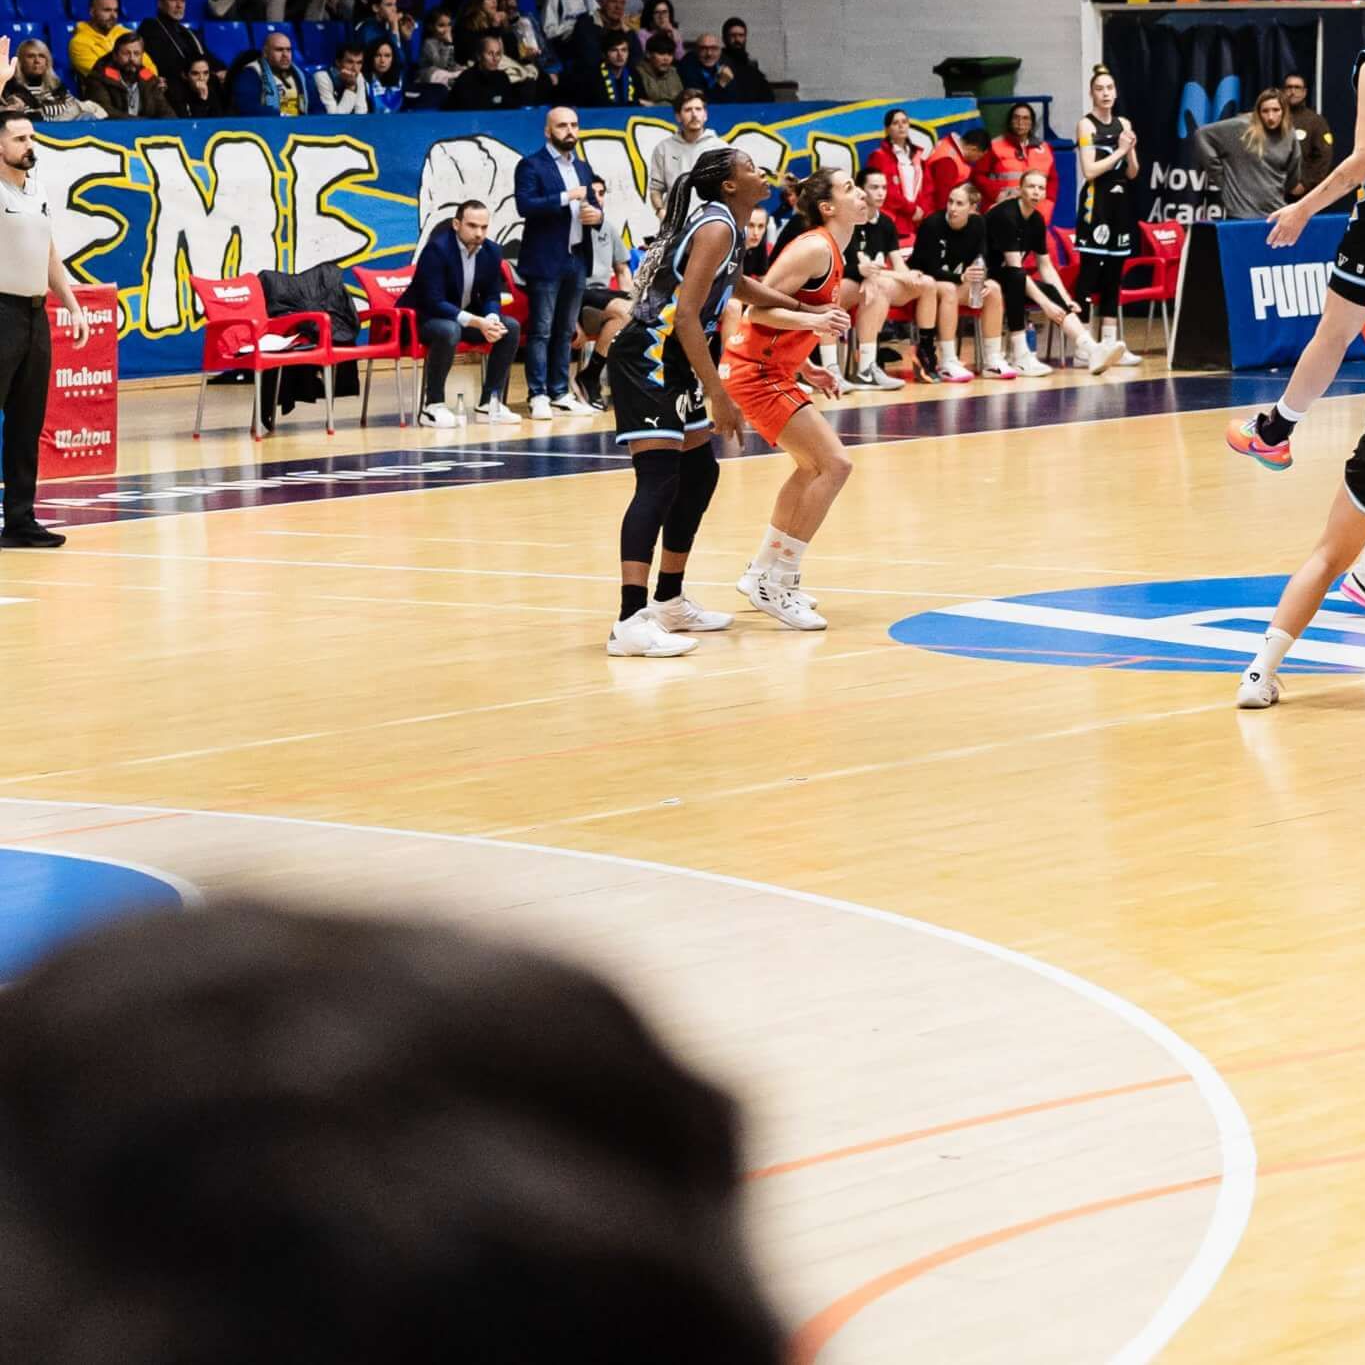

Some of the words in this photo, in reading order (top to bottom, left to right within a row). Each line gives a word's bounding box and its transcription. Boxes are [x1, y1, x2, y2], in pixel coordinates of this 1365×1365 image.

[56, 305, 113, 327] Mhou
[55, 367, 113, 388] Mahou
[54, 427, 111, 450] Mahou
